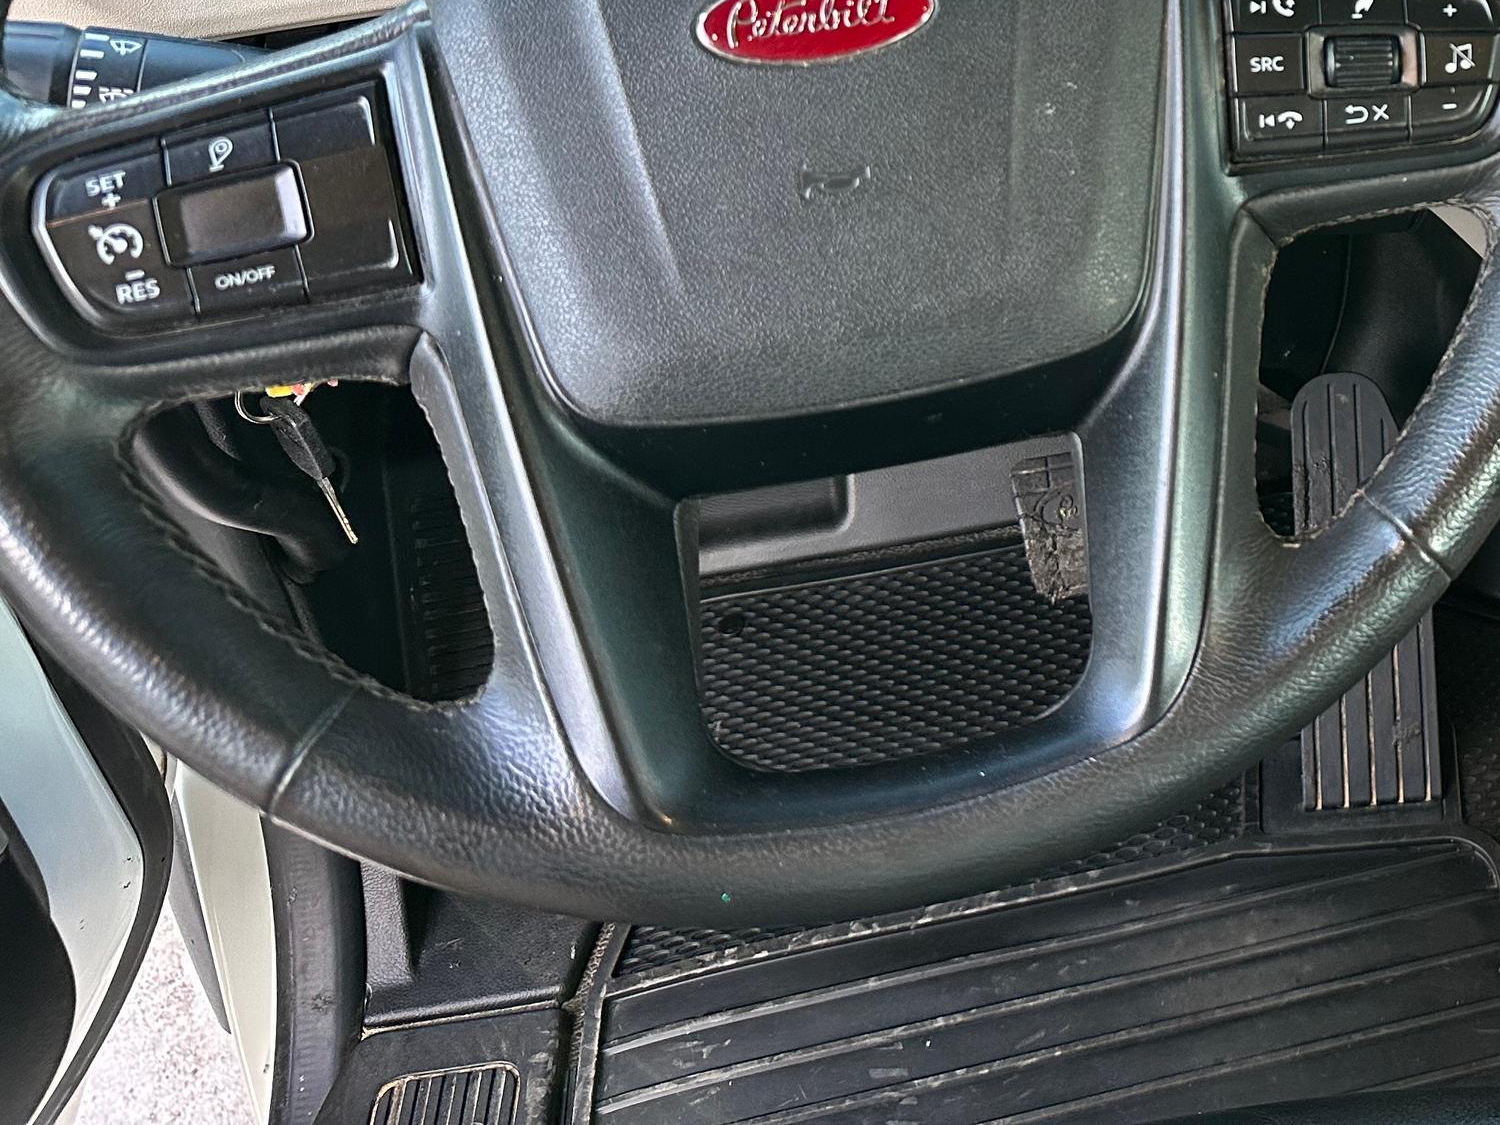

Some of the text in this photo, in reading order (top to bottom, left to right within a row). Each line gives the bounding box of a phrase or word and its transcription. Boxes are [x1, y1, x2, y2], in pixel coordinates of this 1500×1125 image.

[1250, 55, 1285, 72] SRC
[85, 170, 127, 196] SET
[214, 264, 276, 291] ON/OFF
[115, 278, 161, 305] RES
